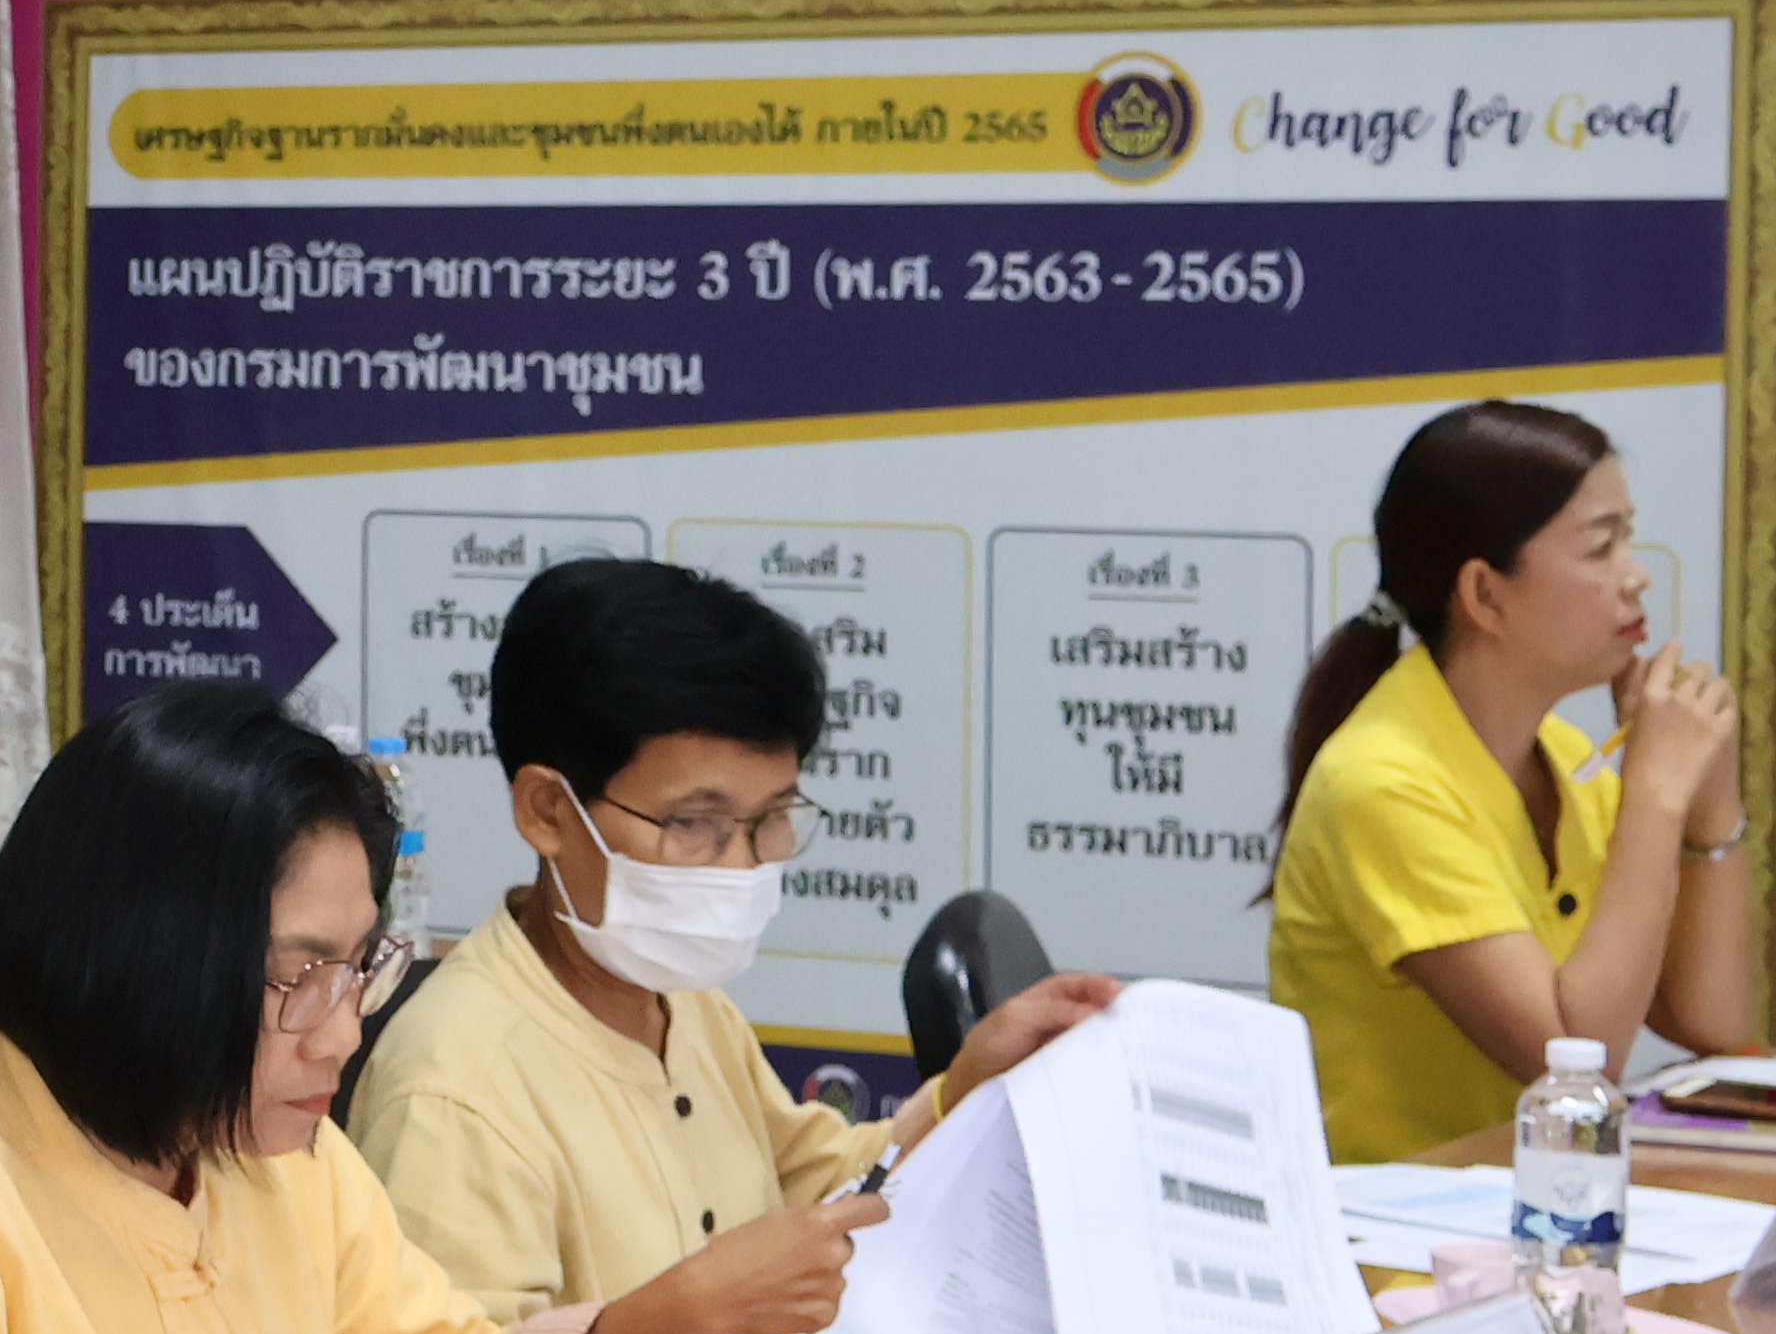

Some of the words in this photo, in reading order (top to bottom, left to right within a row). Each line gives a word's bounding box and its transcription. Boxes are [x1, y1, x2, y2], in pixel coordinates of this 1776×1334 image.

[815, 99, 946, 146] ภายในปี
[963, 111, 1048, 146] 2565
[1230, 89, 1433, 165] Change
[1446, 87, 1533, 169] for
[1546, 84, 1692, 151] Good
[127, 240, 676, 312] แผนปฏิบัติราชการระยะ
[697, 252, 731, 301] 3
[750, 238, 791, 299] ปี
[813, 248, 943, 310] (พ.ศ.
[124, 334, 704, 416] ของกรมการพัฒนาชุมชน
[850, 553, 867, 580] 2
[1183, 565, 1200, 590] 3
[108, 596, 130, 627] 4
[140, 587, 260, 631] ประเด็น
[411, 596, 503, 641] สร้าง
[104, 642, 261, 681] การพัฒนา
[814, 616, 888, 659] สริม
[1050, 625, 1249, 674] เสริมสร้าง
[449, 670, 492, 717] ชุม
[825, 677, 903, 731] ฐกิจ
[402, 707, 499, 759] พึ่งตน
[1060, 693, 1238, 746] ทุนชุมชน
[1107, 744, 1185, 796] ให้มี
[820, 798, 917, 842] ายตัว
[1028, 816, 1271, 866] ธรรมาภิบาล
[782, 870, 919, 920] งสมดุล
